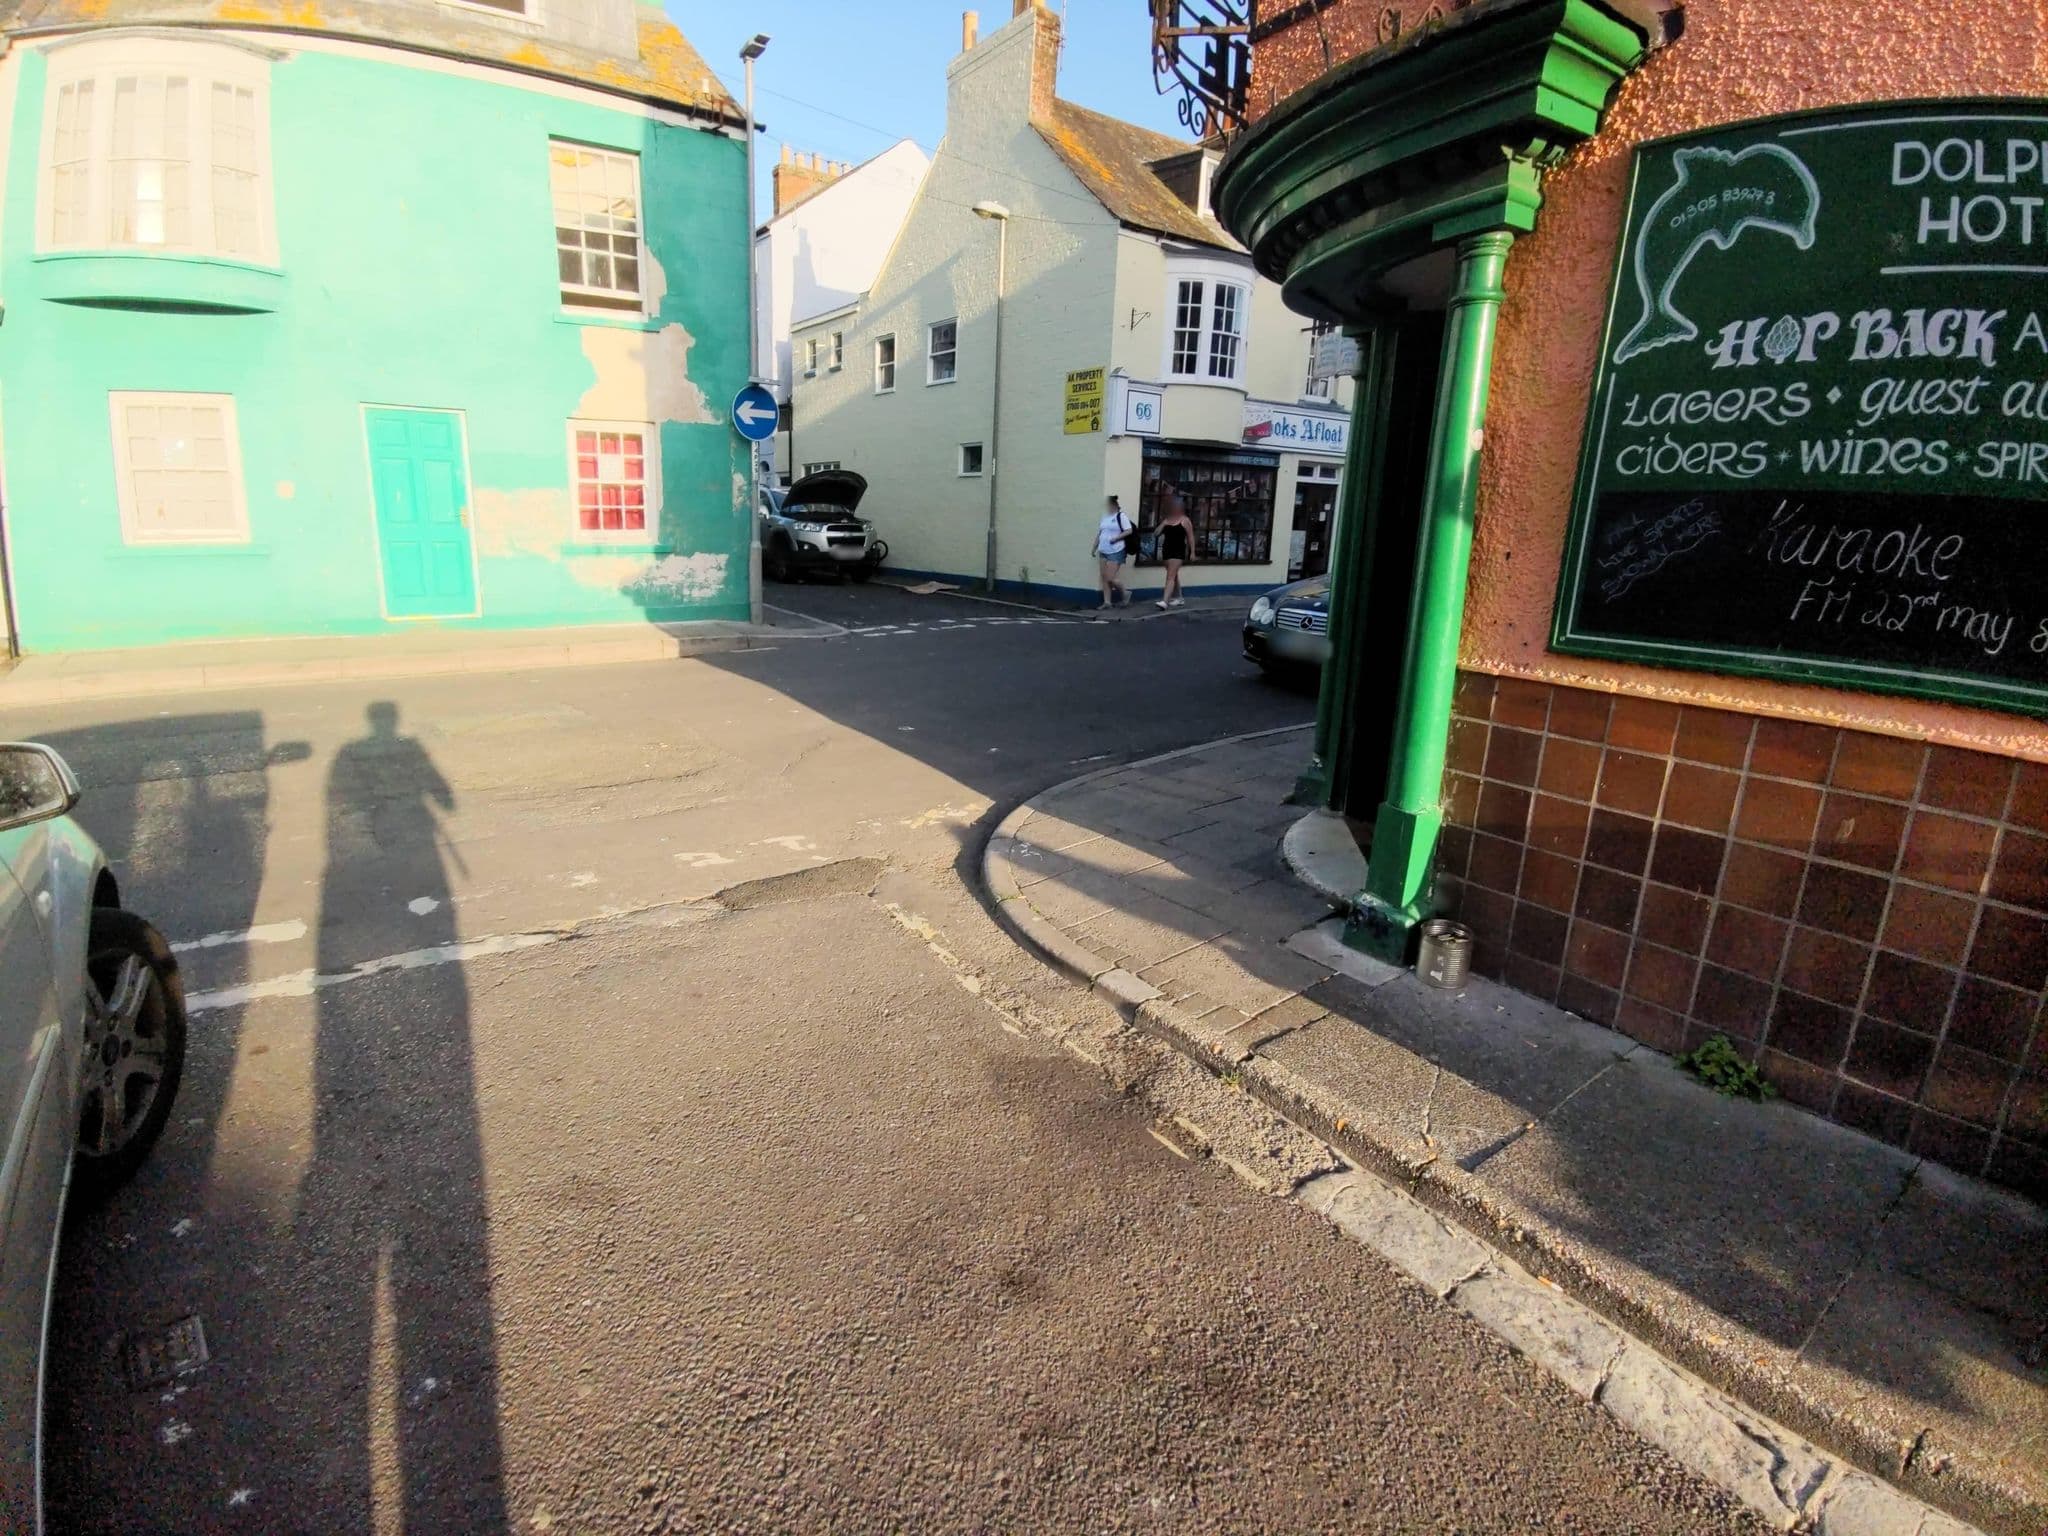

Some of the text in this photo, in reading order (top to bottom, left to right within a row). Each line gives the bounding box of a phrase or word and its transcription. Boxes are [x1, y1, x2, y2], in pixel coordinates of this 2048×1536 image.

[1892, 138, 2048, 185] DOLP
[1670, 194, 1718, 228] 01305
[1705, 312, 1841, 369] HOP
[1849, 308, 2008, 367] BACK
[1136, 402, 1152, 421] 66
[1857, 375, 1991, 427] guest
[1300, 418, 1344, 443] Afloat
